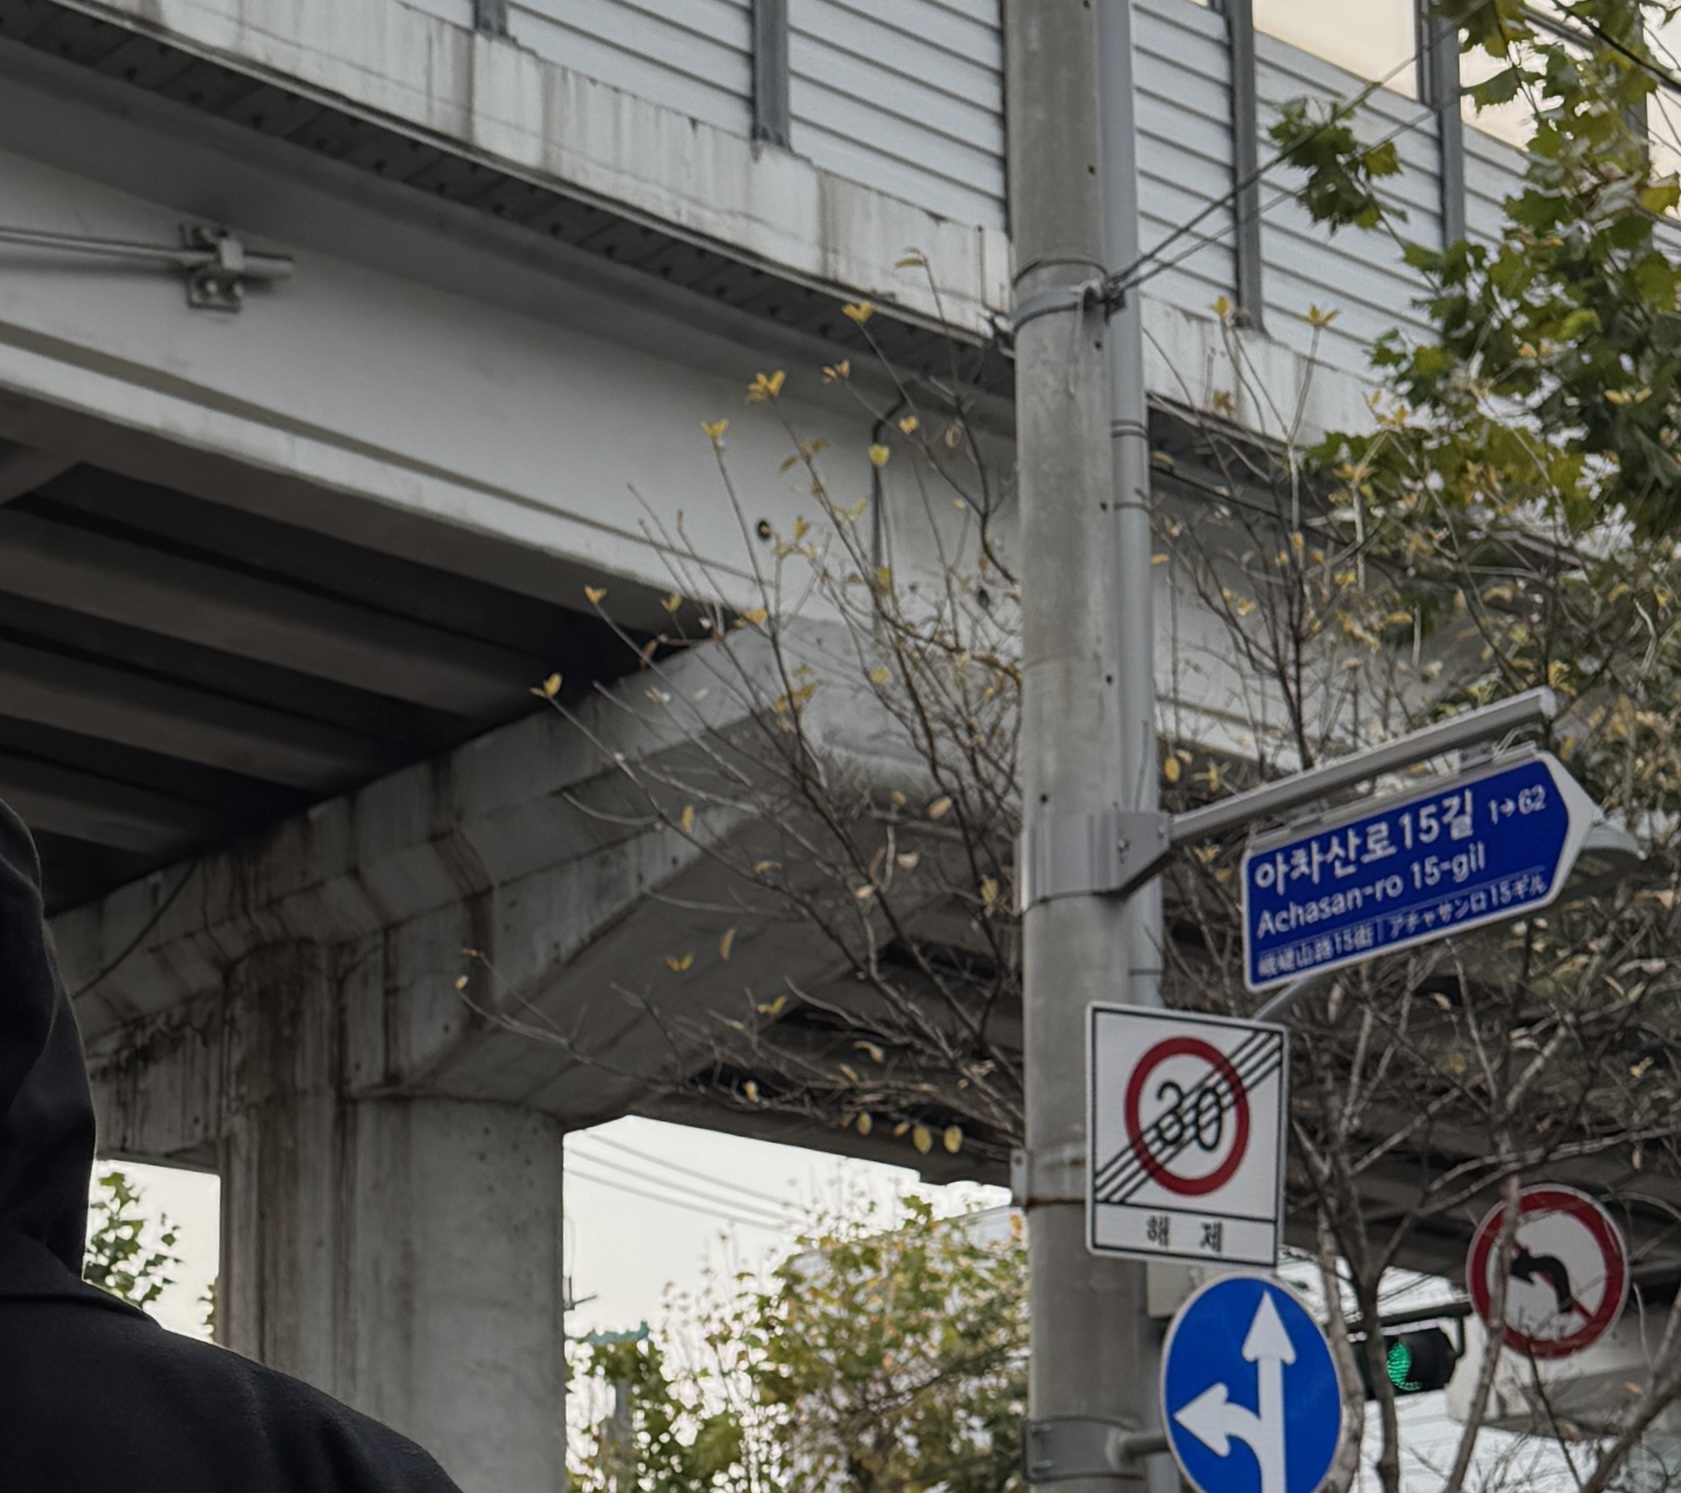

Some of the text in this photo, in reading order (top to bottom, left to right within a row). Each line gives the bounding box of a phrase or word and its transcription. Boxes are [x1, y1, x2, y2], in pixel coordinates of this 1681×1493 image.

[1254, 787, 1473, 897] 아차산로15길
[1256, 840, 1486, 940] Achasan-ro 15-gil
[1157, 1080, 1221, 1151] 30
